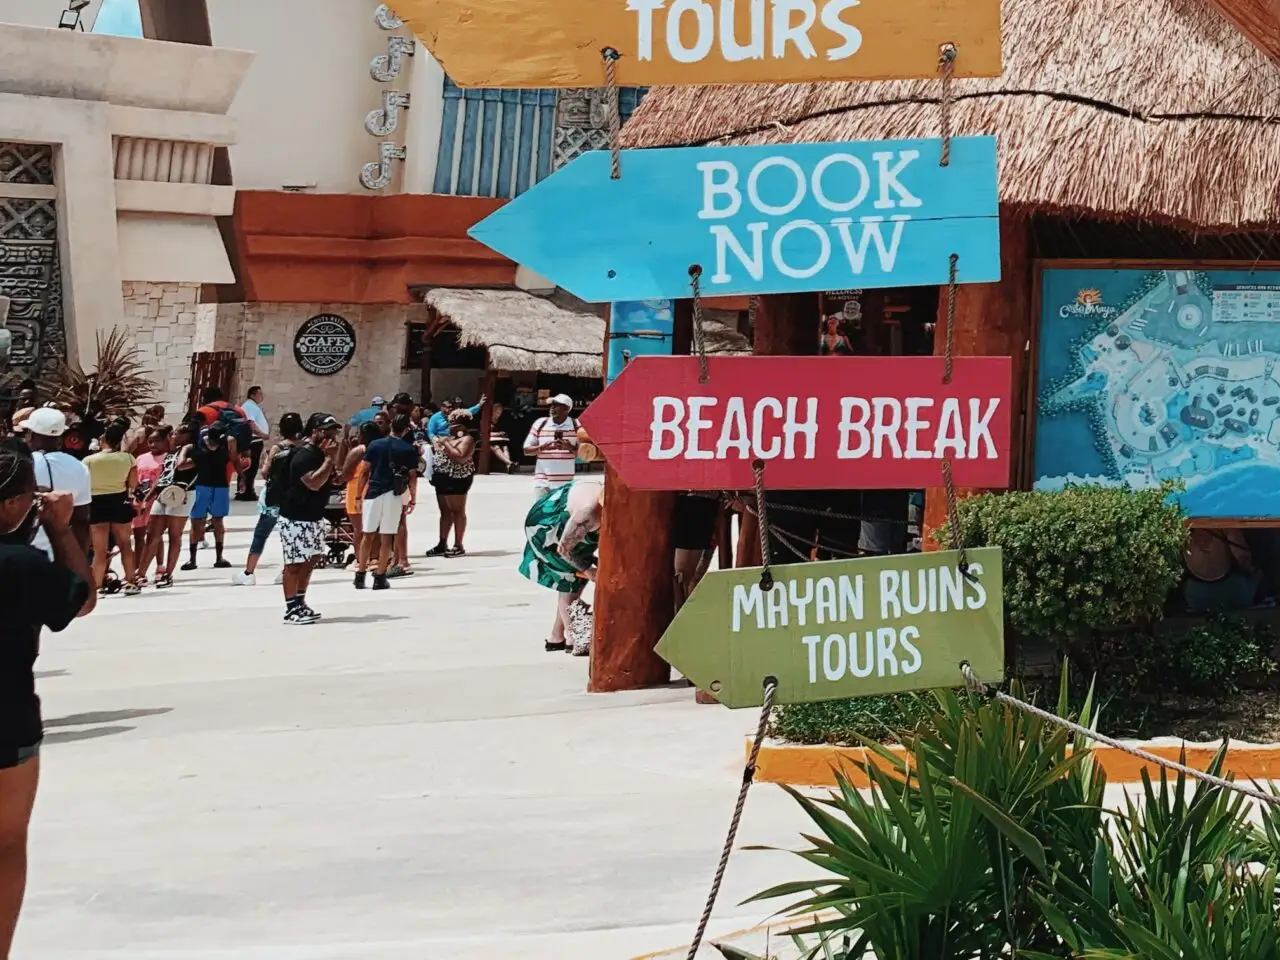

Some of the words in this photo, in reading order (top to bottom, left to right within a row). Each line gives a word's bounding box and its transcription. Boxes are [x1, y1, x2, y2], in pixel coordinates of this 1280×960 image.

[696, 150, 922, 220] BOOK
[709, 214, 911, 283] NOW
[649, 396, 819, 460] BEACH
[837, 396, 1000, 460] BREAK
[732, 574, 864, 633] MAYAN
[879, 562, 987, 620] RUINS
[802, 625, 922, 684] TOURS
